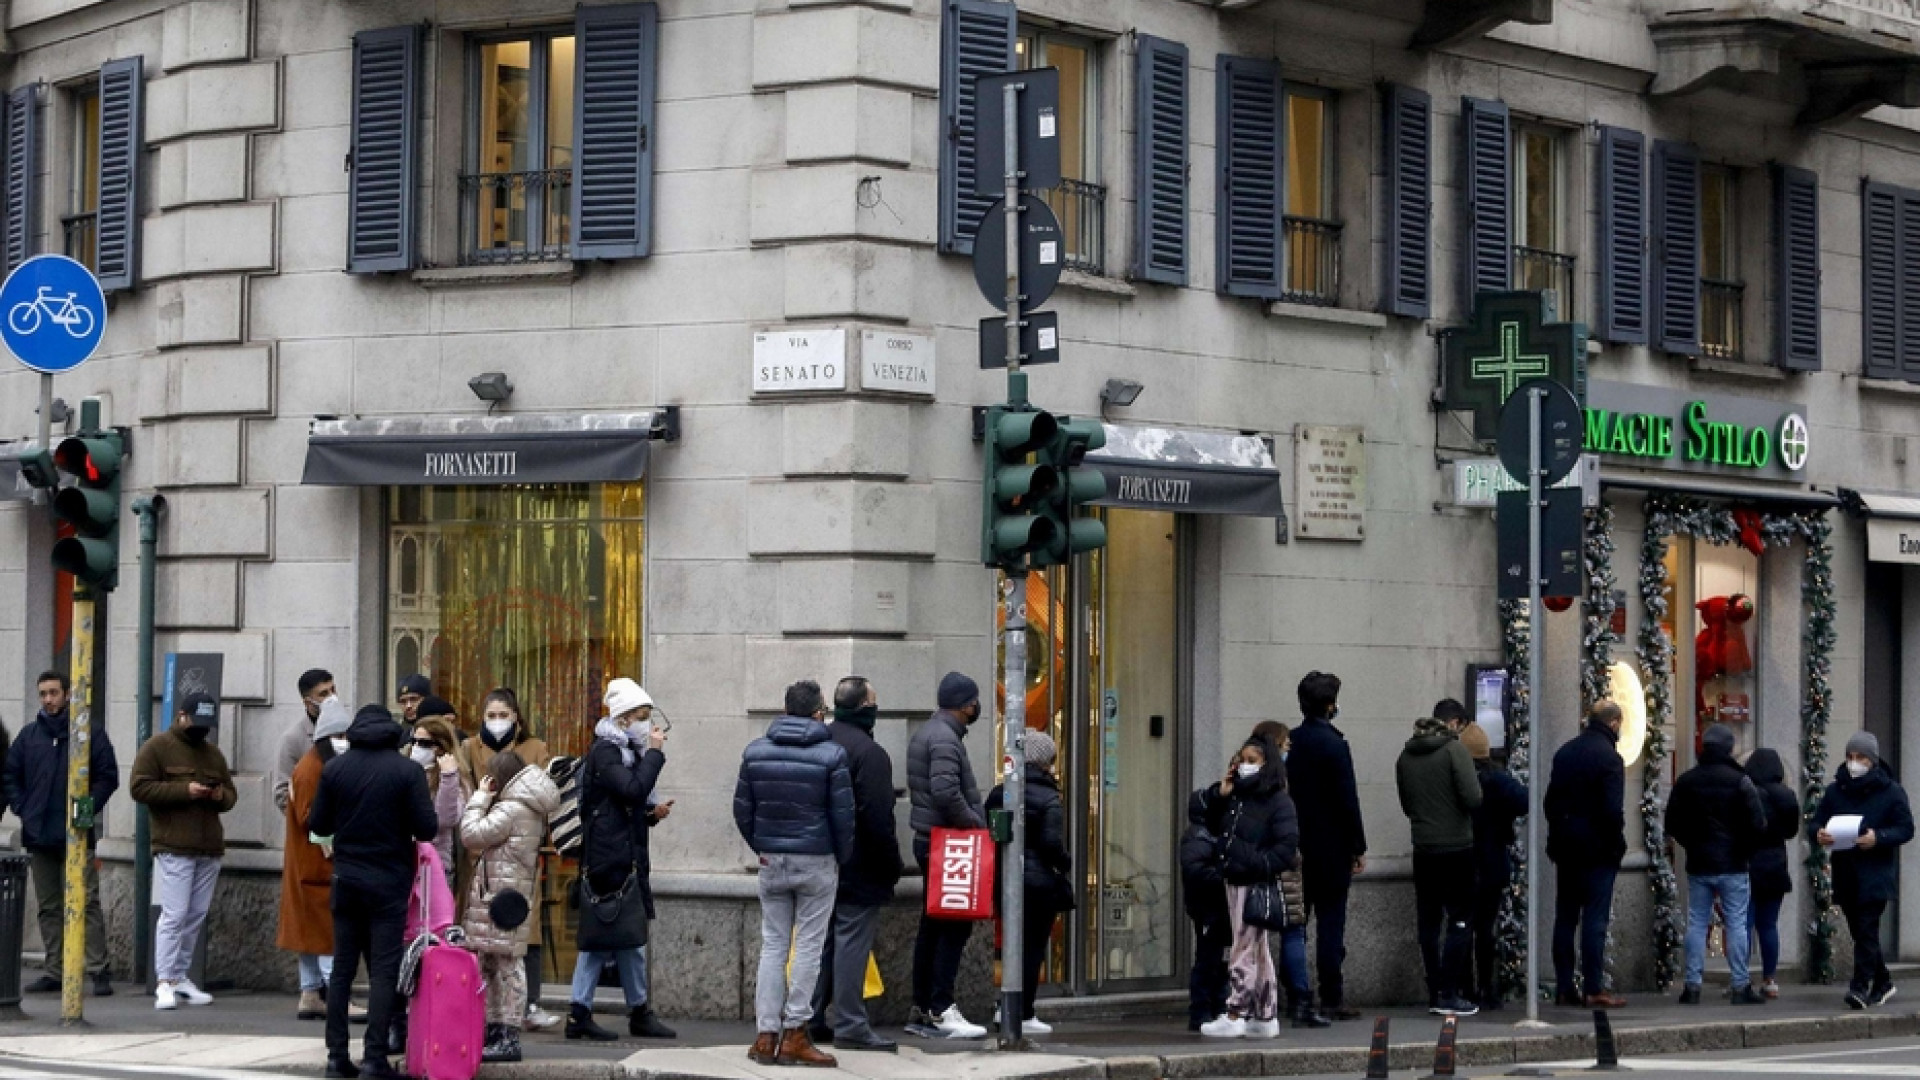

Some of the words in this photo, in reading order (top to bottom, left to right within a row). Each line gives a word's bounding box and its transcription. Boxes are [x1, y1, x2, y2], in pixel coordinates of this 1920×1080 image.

[788, 337, 809, 347] VIA
[886, 338, 913, 350] CORSO
[760, 364, 836, 382] SENATO
[872, 362, 928, 383] VENEZIA
[1582, 406, 1674, 458] MACIE
[423, 450, 517, 477] FORNASETTI
[1118, 475, 1192, 503] FORNASETTI
[940, 834, 975, 910] DIESEL
